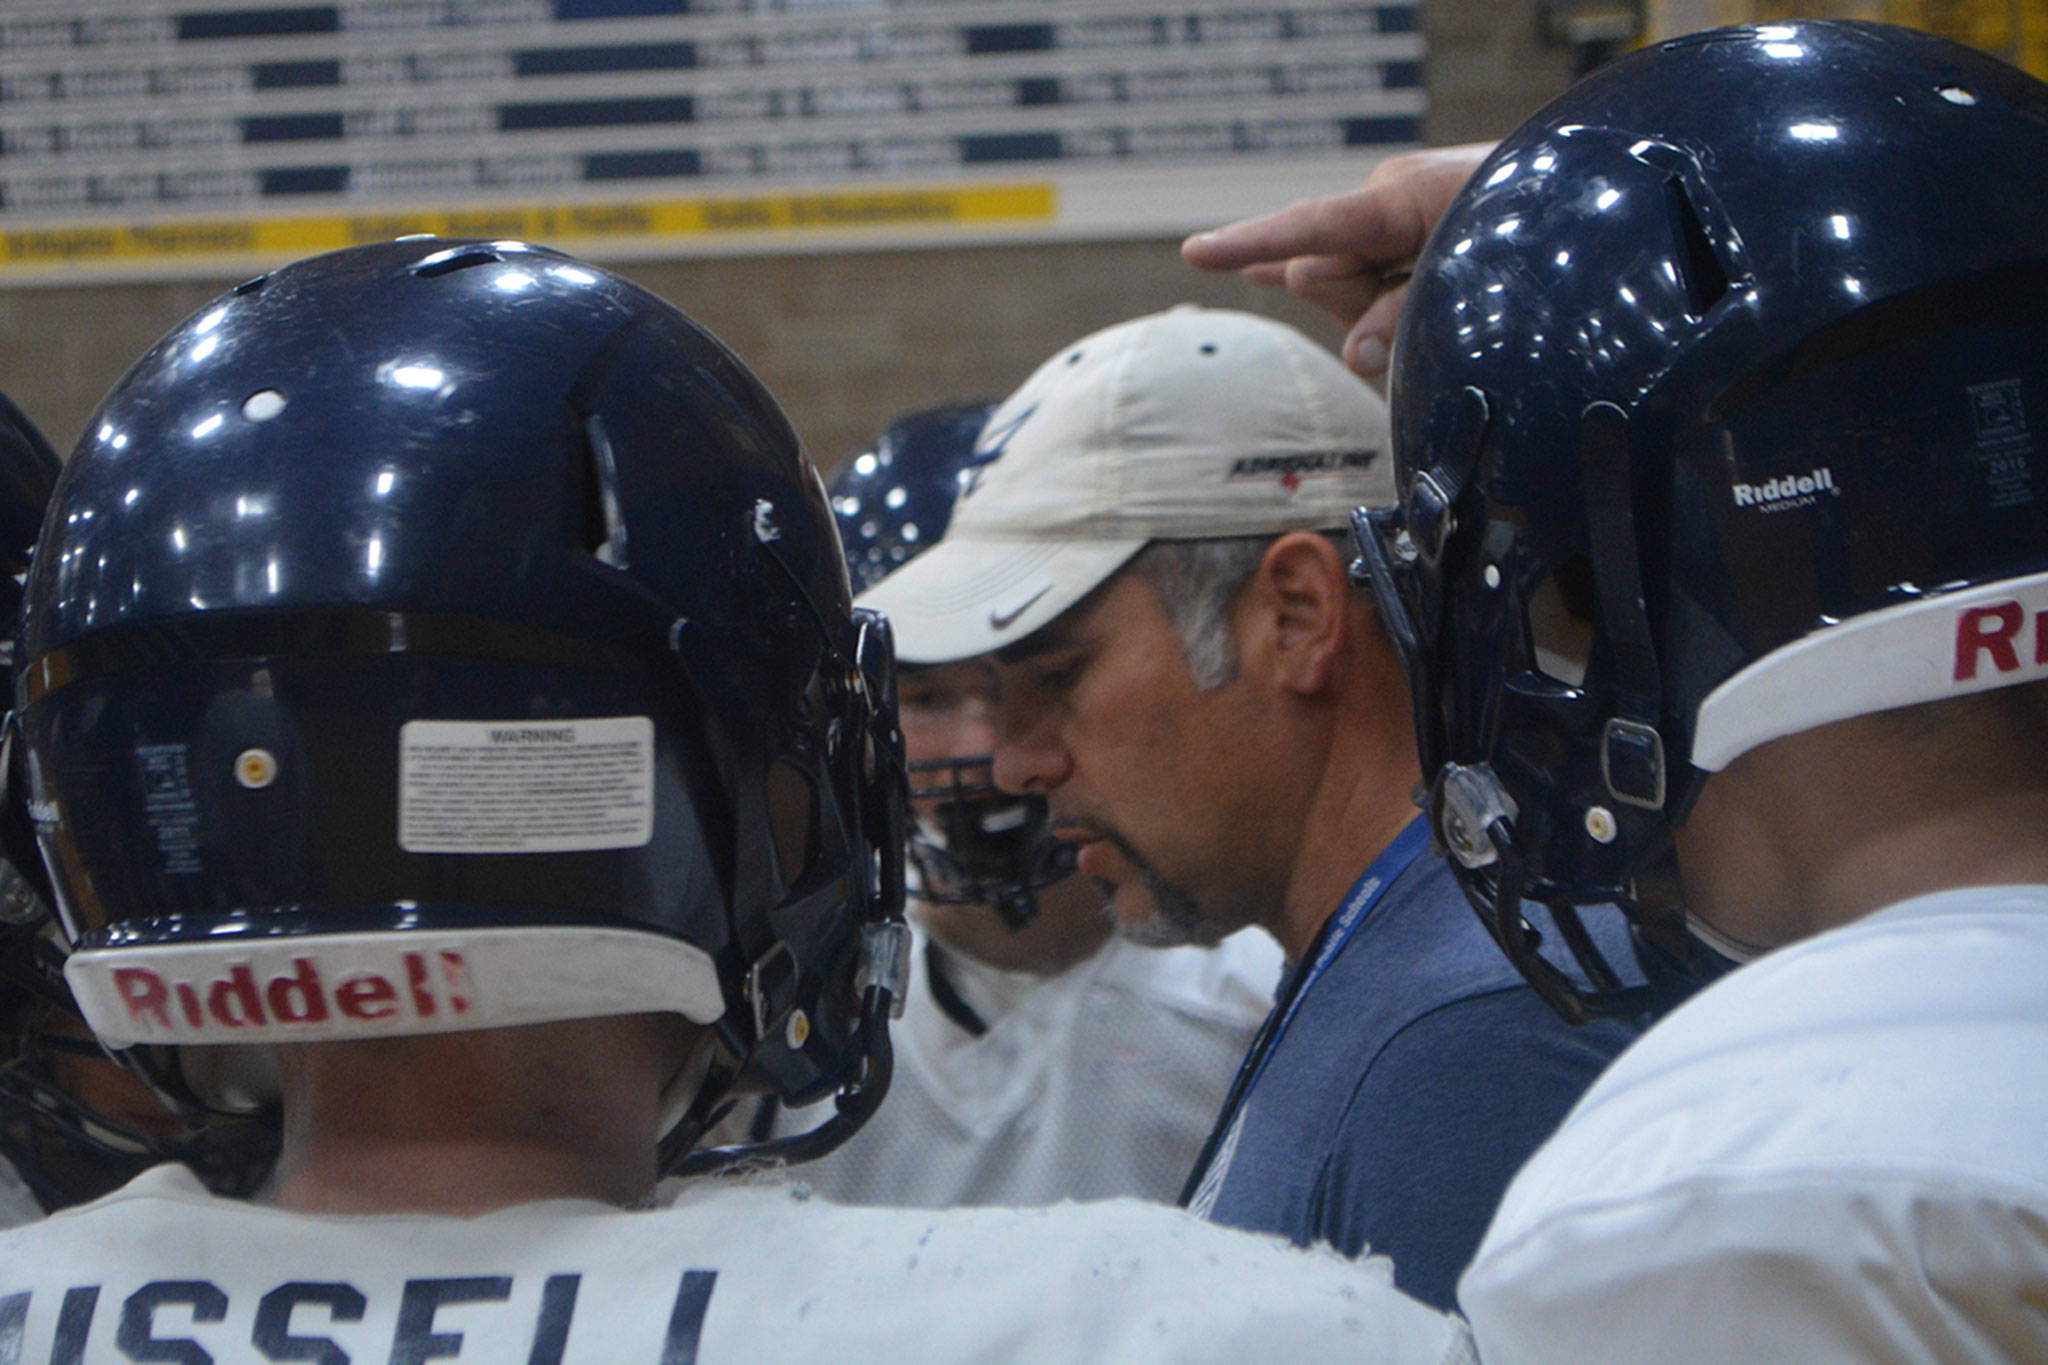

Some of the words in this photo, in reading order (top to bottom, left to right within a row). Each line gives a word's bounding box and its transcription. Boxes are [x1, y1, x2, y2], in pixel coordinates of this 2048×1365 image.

[1732, 467, 1834, 506] Riddell
[1759, 495, 1816, 514] MEDIUM
[490, 728, 575, 744] WARNING
